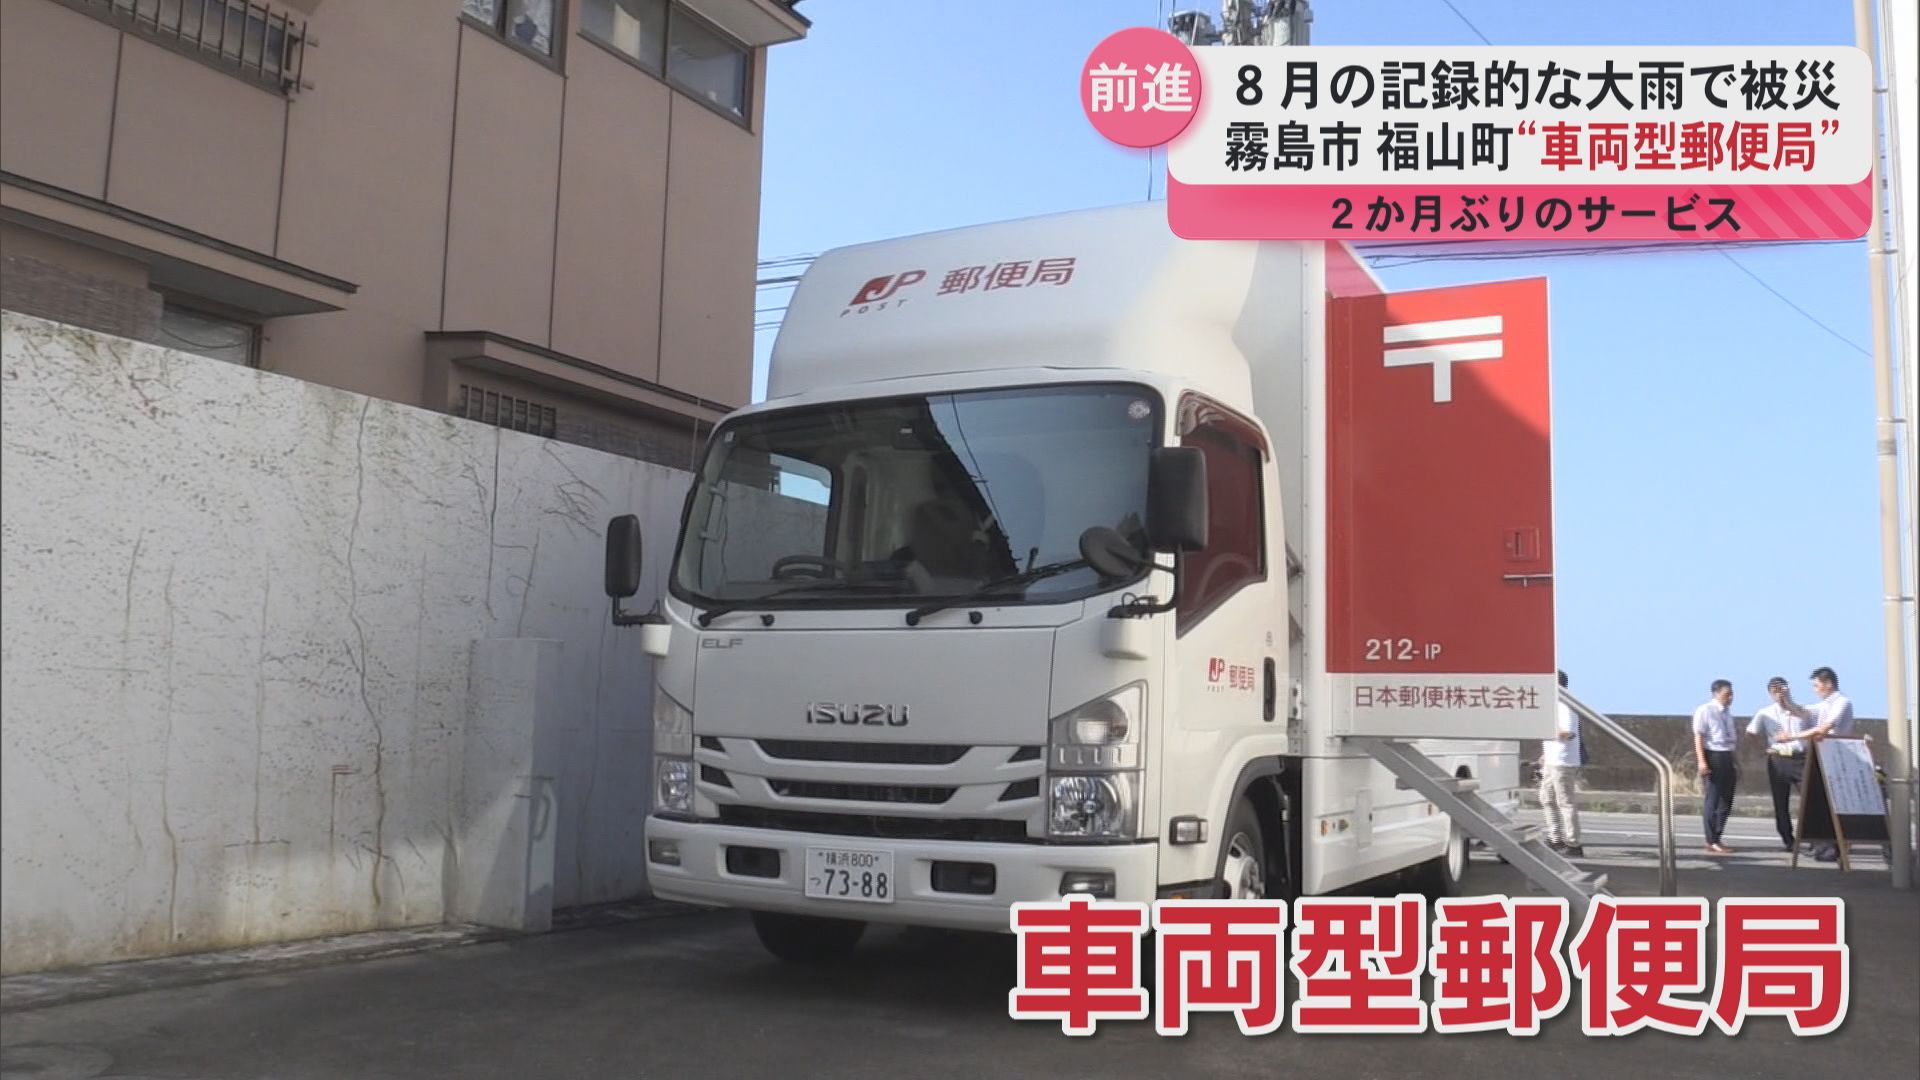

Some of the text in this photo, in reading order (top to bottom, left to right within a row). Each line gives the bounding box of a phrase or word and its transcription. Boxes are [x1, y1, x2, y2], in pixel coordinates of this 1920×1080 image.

[936, 257, 1076, 296] 郵便局
[840, 299, 908, 318] POST
[701, 638, 744, 649] ELF
[1355, 685, 1540, 710] 日本郵便株式会社
[806, 702, 910, 727] ISUZU
[824, 868, 888, 899] 73-88
